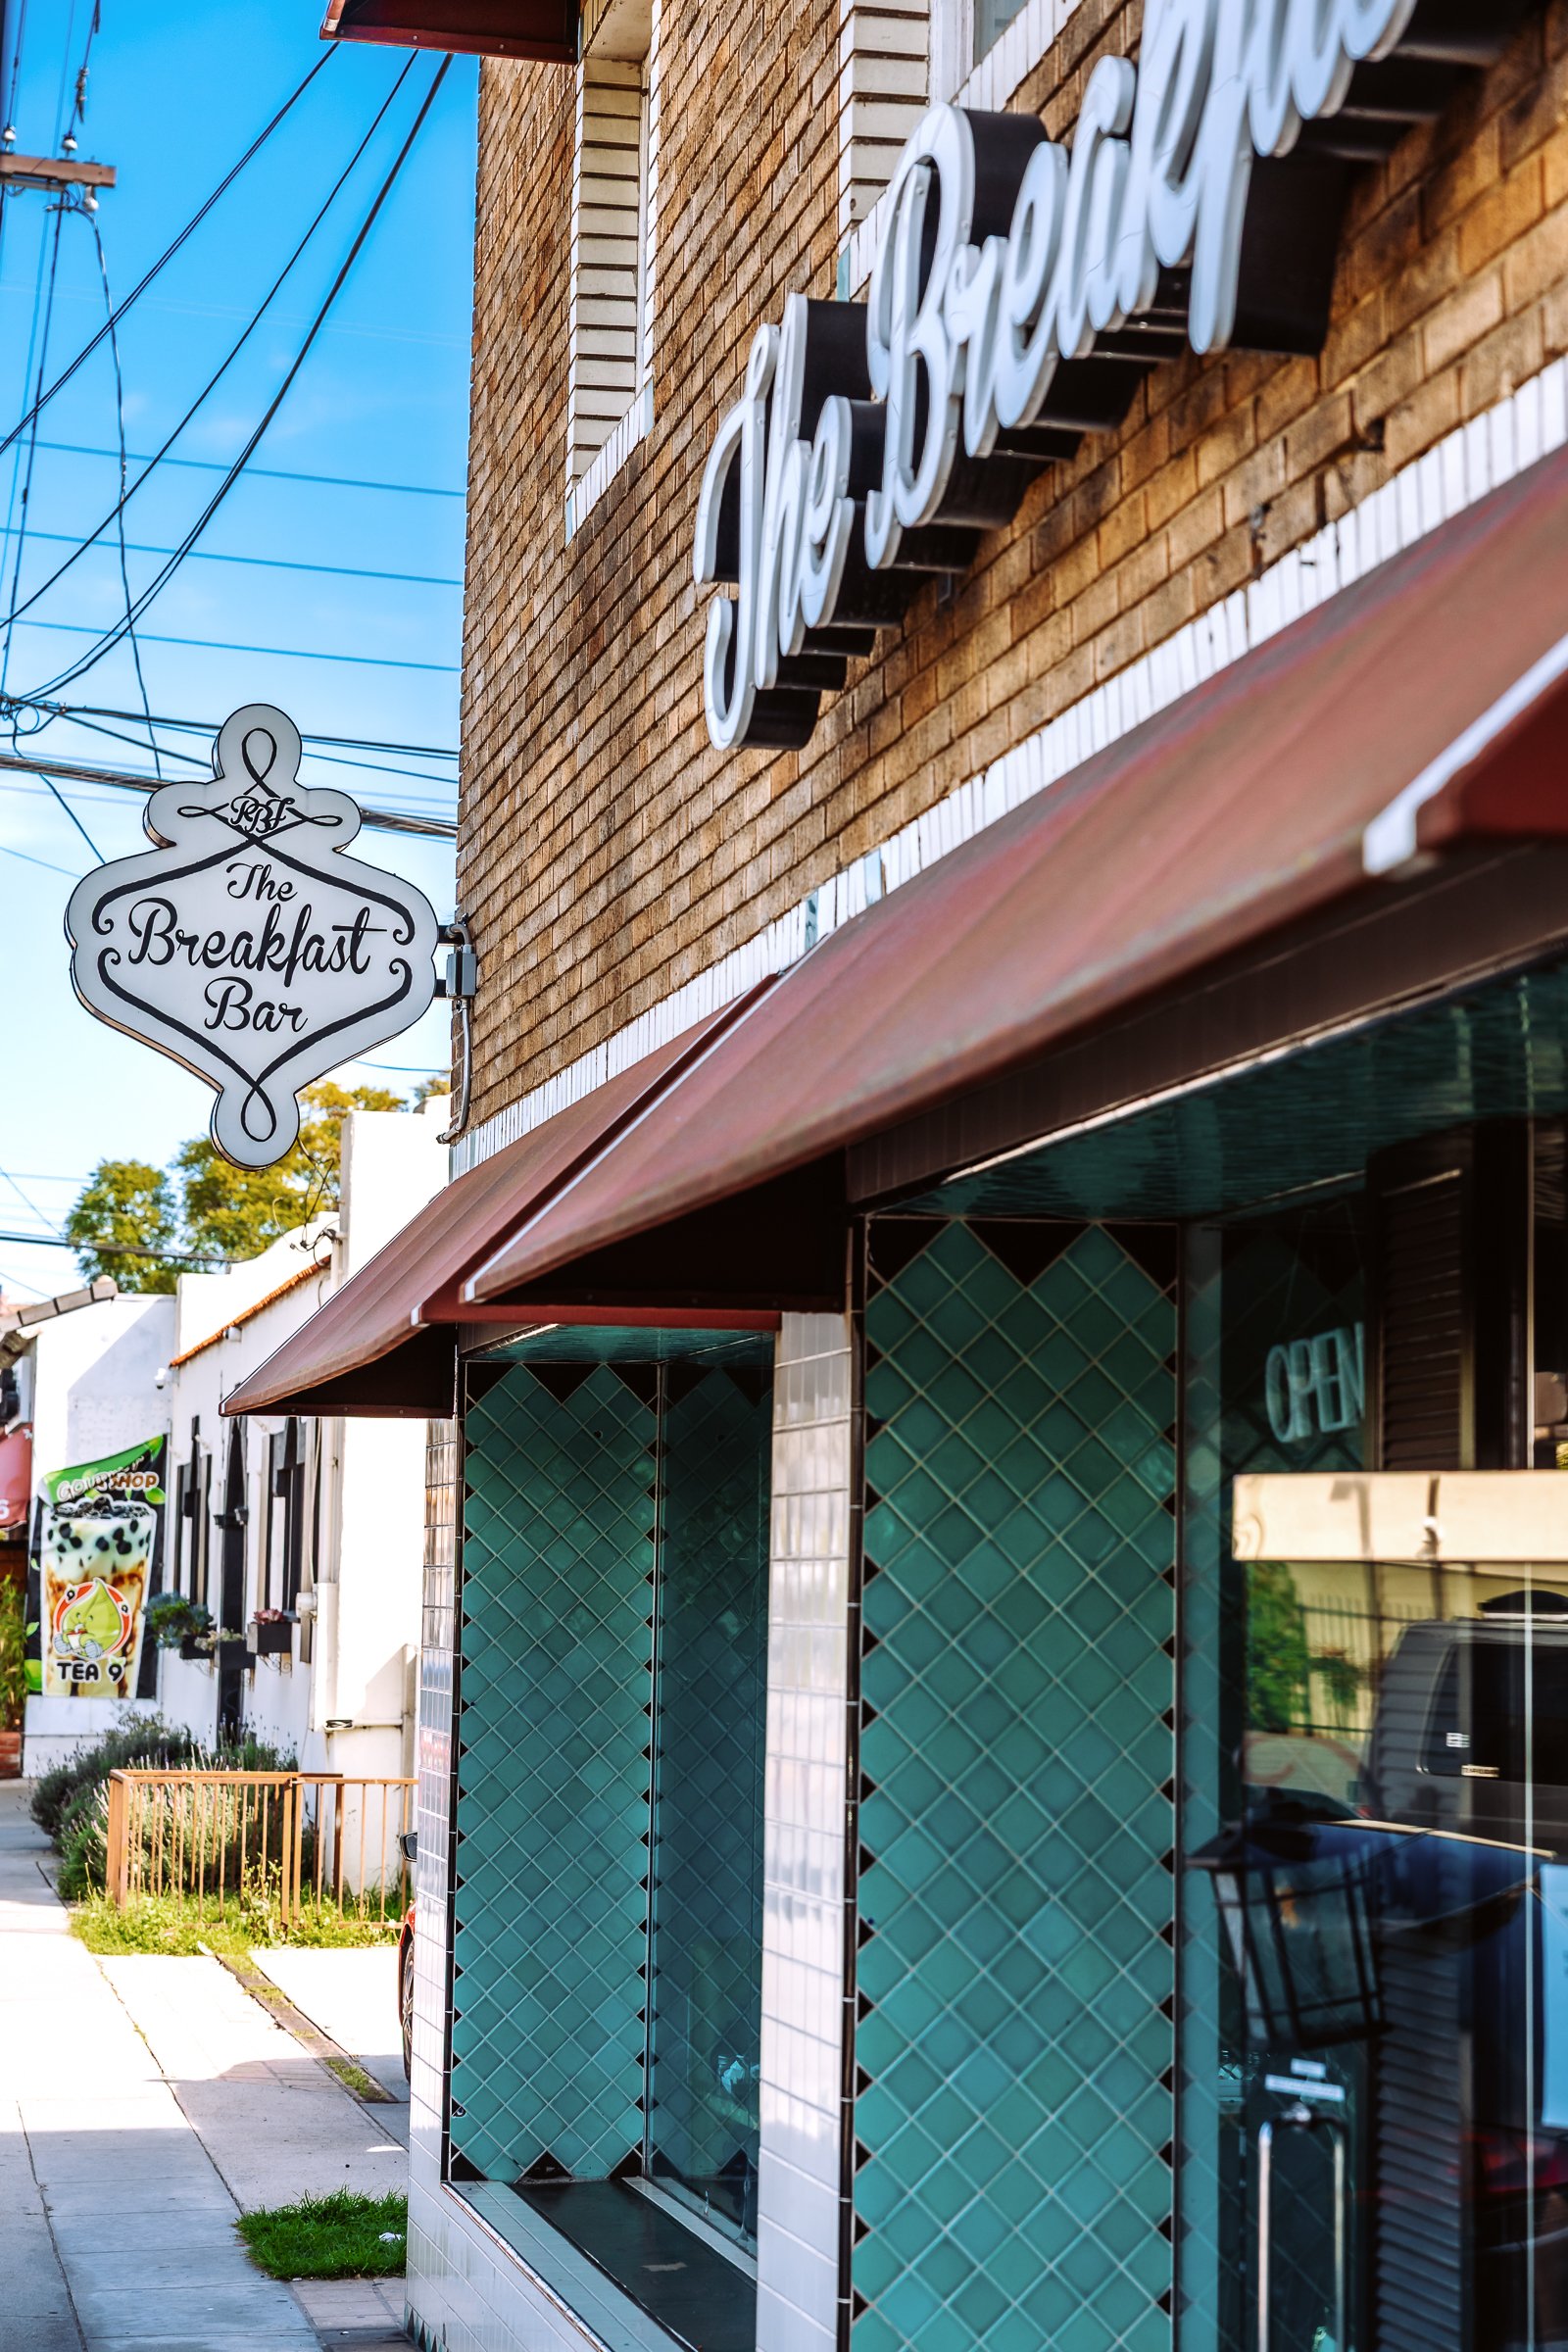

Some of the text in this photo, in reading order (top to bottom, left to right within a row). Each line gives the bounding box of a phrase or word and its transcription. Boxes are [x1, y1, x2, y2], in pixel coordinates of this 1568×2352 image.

[693, 292, 854, 750] The
[226, 862, 298, 901] The
[127, 898, 387, 988] Breakfast
[204, 976, 308, 1032] Bar
[1265, 1322, 1364, 1443] OPEN
[57, 1662, 122, 1682] TEA 9
